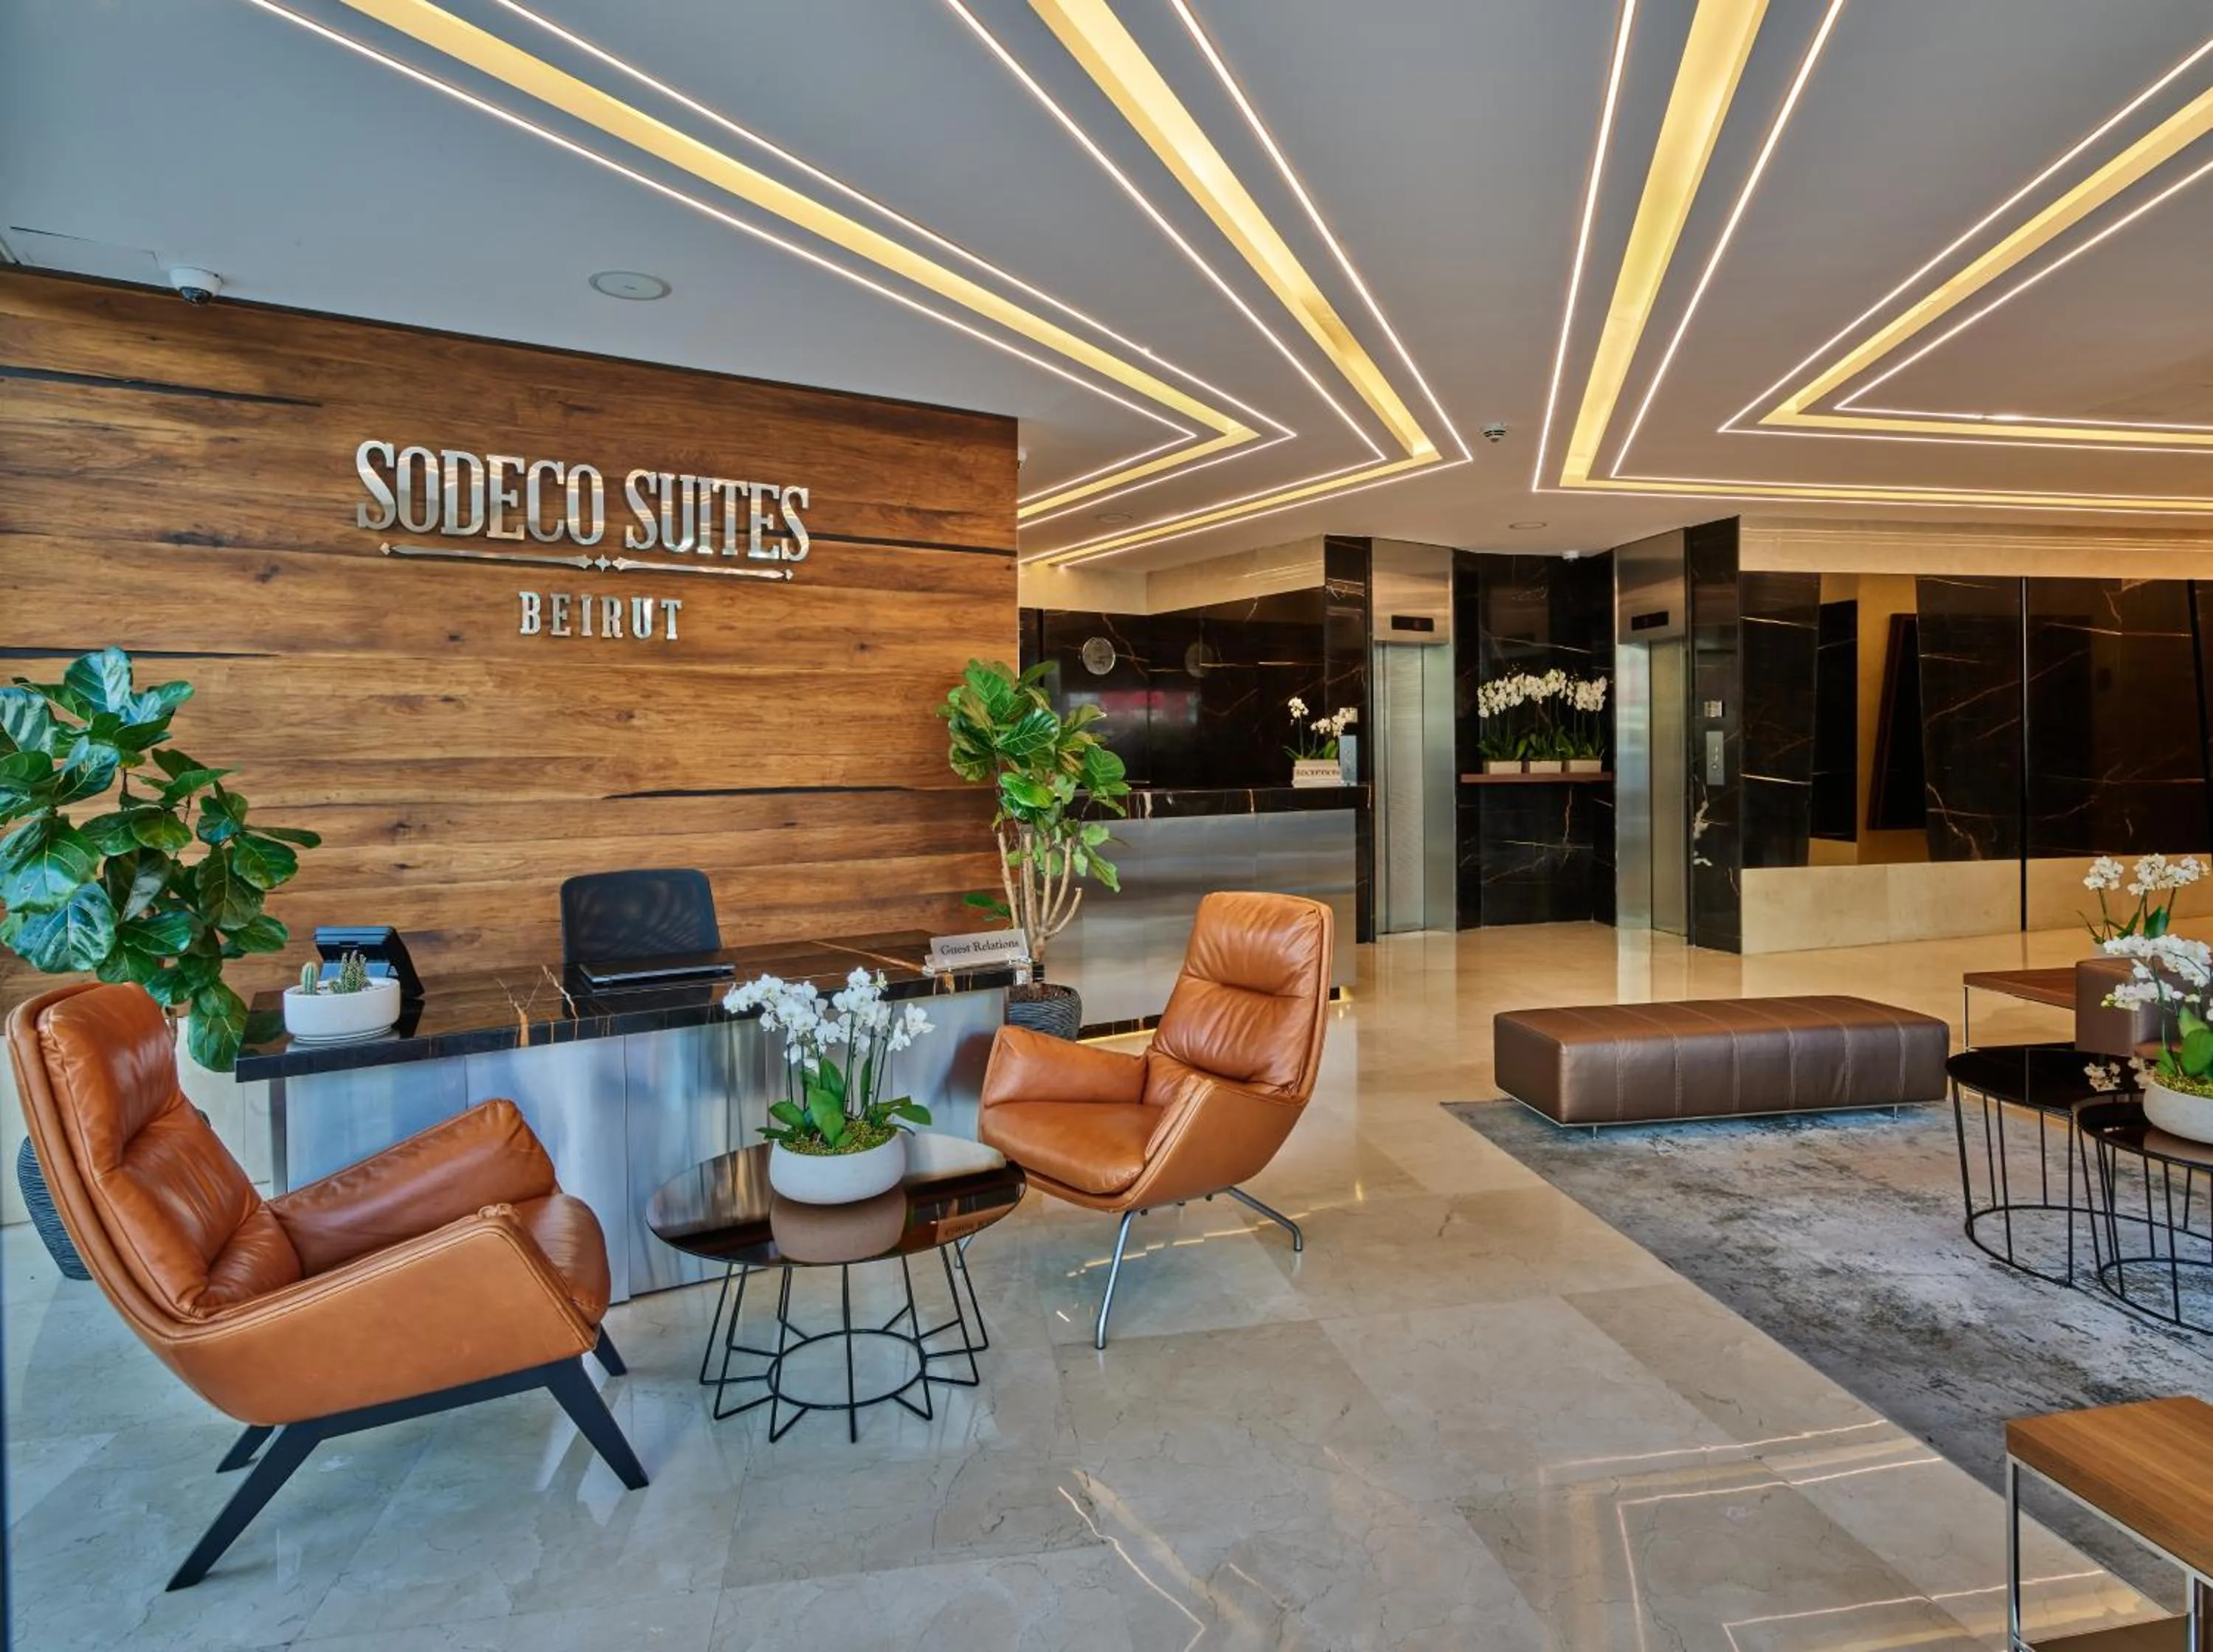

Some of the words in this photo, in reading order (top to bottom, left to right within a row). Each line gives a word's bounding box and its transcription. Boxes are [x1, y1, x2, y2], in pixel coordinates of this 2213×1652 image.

[356, 440, 605, 546] SODECO
[625, 469, 811, 562] SUITES
[519, 591, 682, 641] BEIRUT
[940, 944, 971, 955] Guest
[973, 939, 1019, 951] Relations
